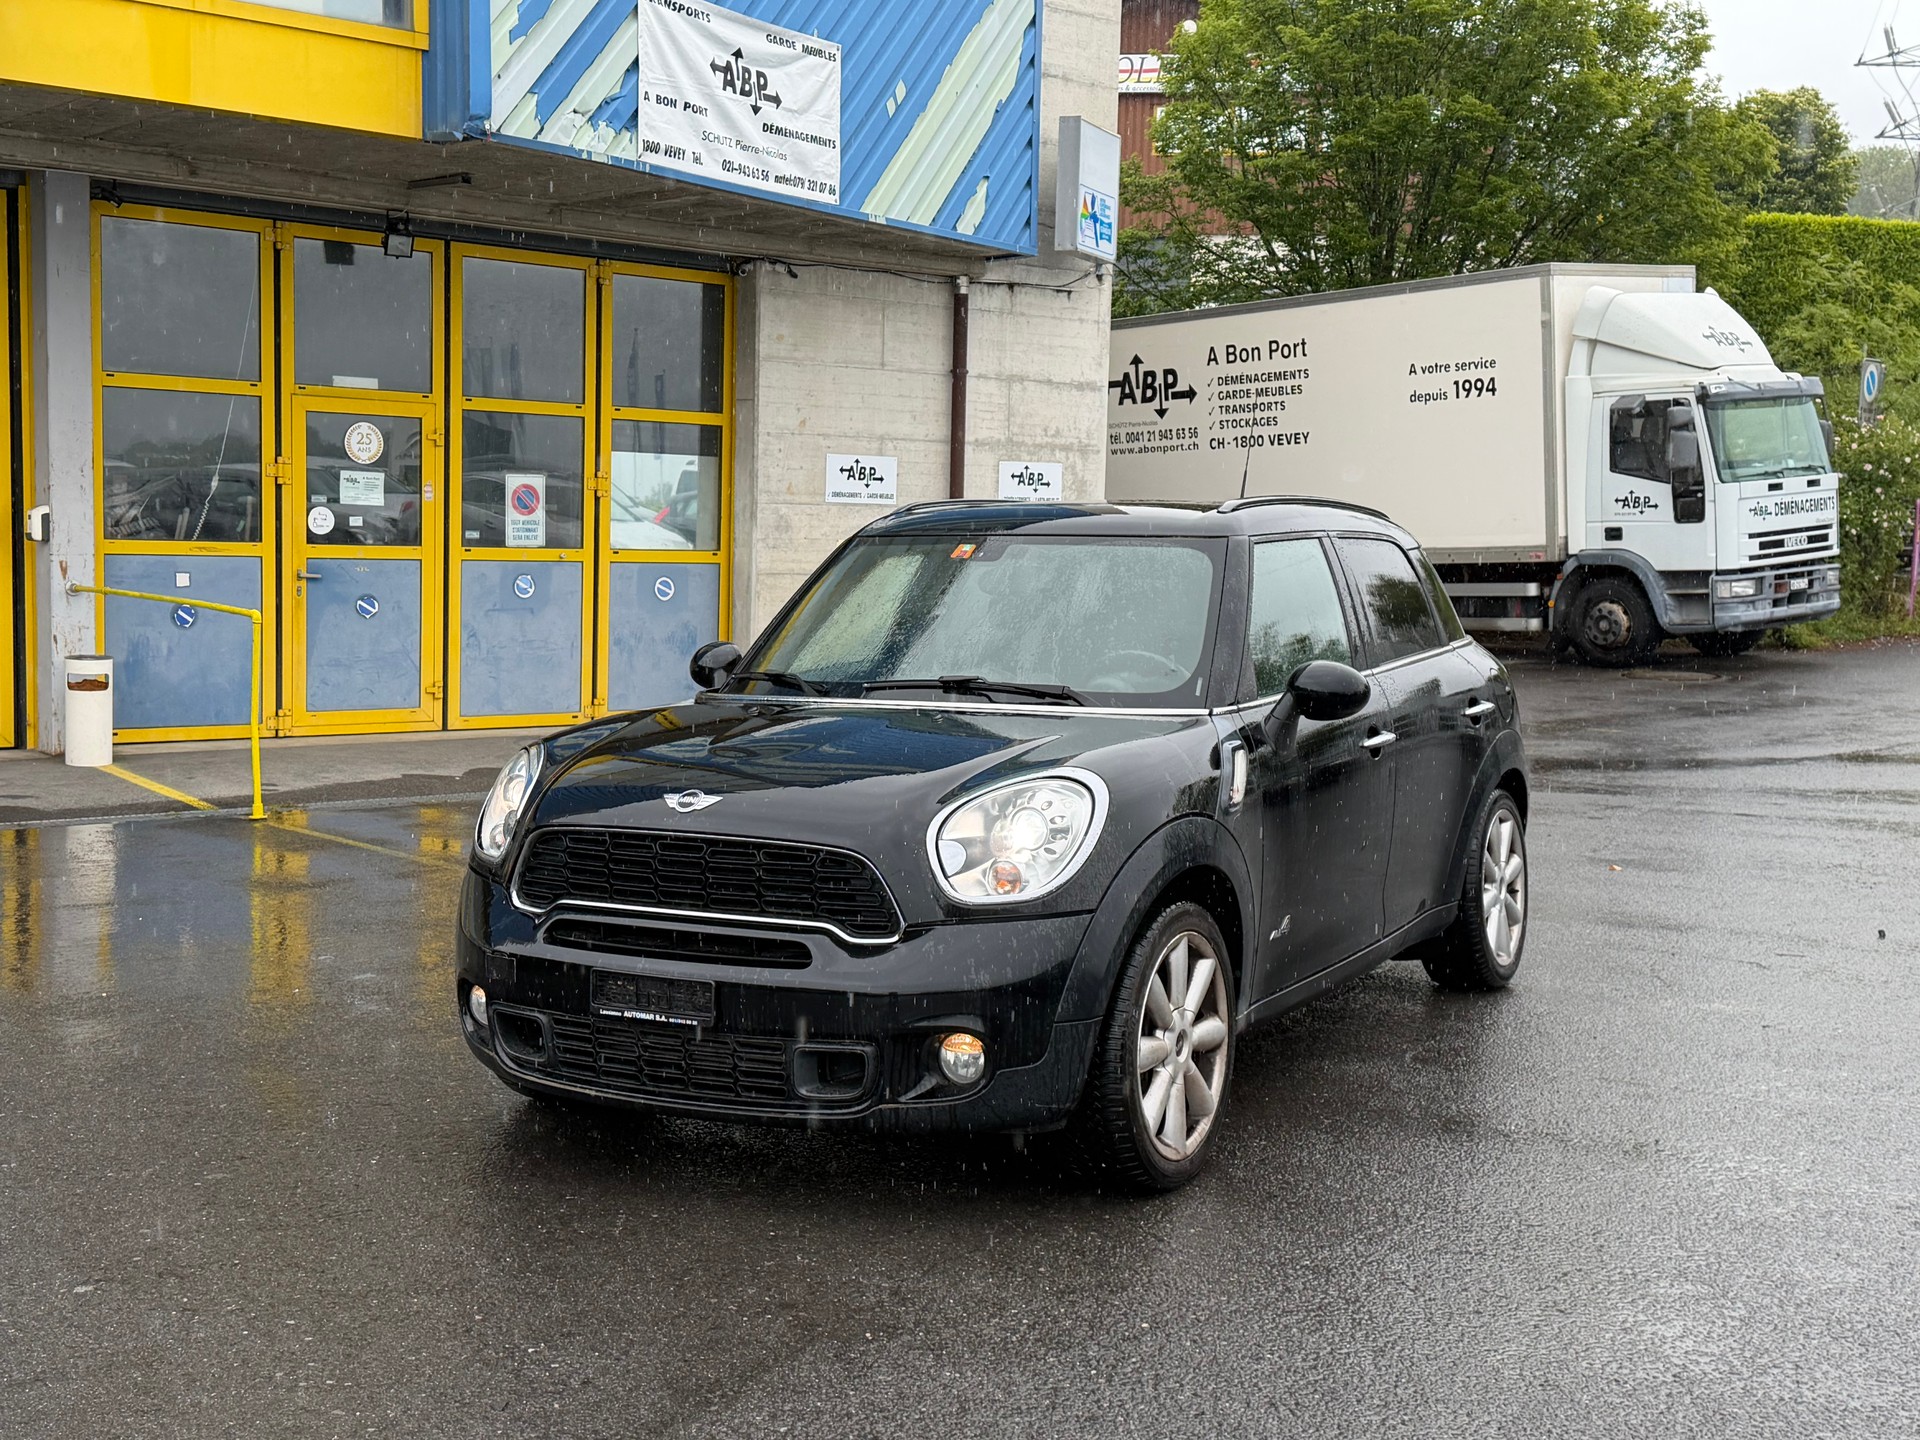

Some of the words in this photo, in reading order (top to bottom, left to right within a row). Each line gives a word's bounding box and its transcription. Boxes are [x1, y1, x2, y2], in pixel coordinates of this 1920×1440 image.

[766, 34, 797, 50] GARDE
[802, 44, 837, 62] MEUBLES
[722, 60, 768, 101] ABP
[643, 91, 651, 102] A
[656, 94, 678, 109] BON
[683, 101, 708, 117] PORT
[762, 122, 836, 149] DÉMÉNAGEMENTS
[642, 139, 661, 154] 1800
[664, 144, 686, 161] VEVEY
[1206, 346, 1219, 366] A
[1226, 344, 1261, 364] Bon
[1268, 338, 1308, 360] Port
[1409, 363, 1418, 376] A
[1421, 362, 1451, 375] votre
[1455, 357, 1497, 372] service
[1217, 369, 1310, 386] DÉMÉNAGEMENTS
[1118, 368, 1179, 405] ABP
[1217, 384, 1303, 401] GARDE-MEUBLES
[1409, 388, 1448, 405] depuis
[1453, 377, 1497, 399] 1994
[1218, 401, 1286, 415] TRANSPORTS
[1219, 416, 1279, 430] STOCKAGES
[356, 432, 372, 445] 25
[1110, 432, 1124, 445] tél.
[1125, 431, 1145, 444] 0041
[1147, 430, 1156, 442] 21
[1158, 429, 1174, 441] 943
[1175, 428, 1187, 440] 63
[1188, 427, 1199, 439] 56
[1268, 432, 1310, 446] VEVEY
[1110, 441, 1200, 455] www.abonport.ch
[847, 465, 877, 481] ABP
[1017, 471, 1044, 486] ABP
[1622, 496, 1651, 509] ABP
[1774, 497, 1835, 516] DÉMÉNAGEMENTS
[1784, 536, 1808, 548] IVECO
[679, 796, 699, 804] MINI
[623, 1010, 654, 1020] AUTOMAR
[655, 1014, 668, 1022] S.A.
